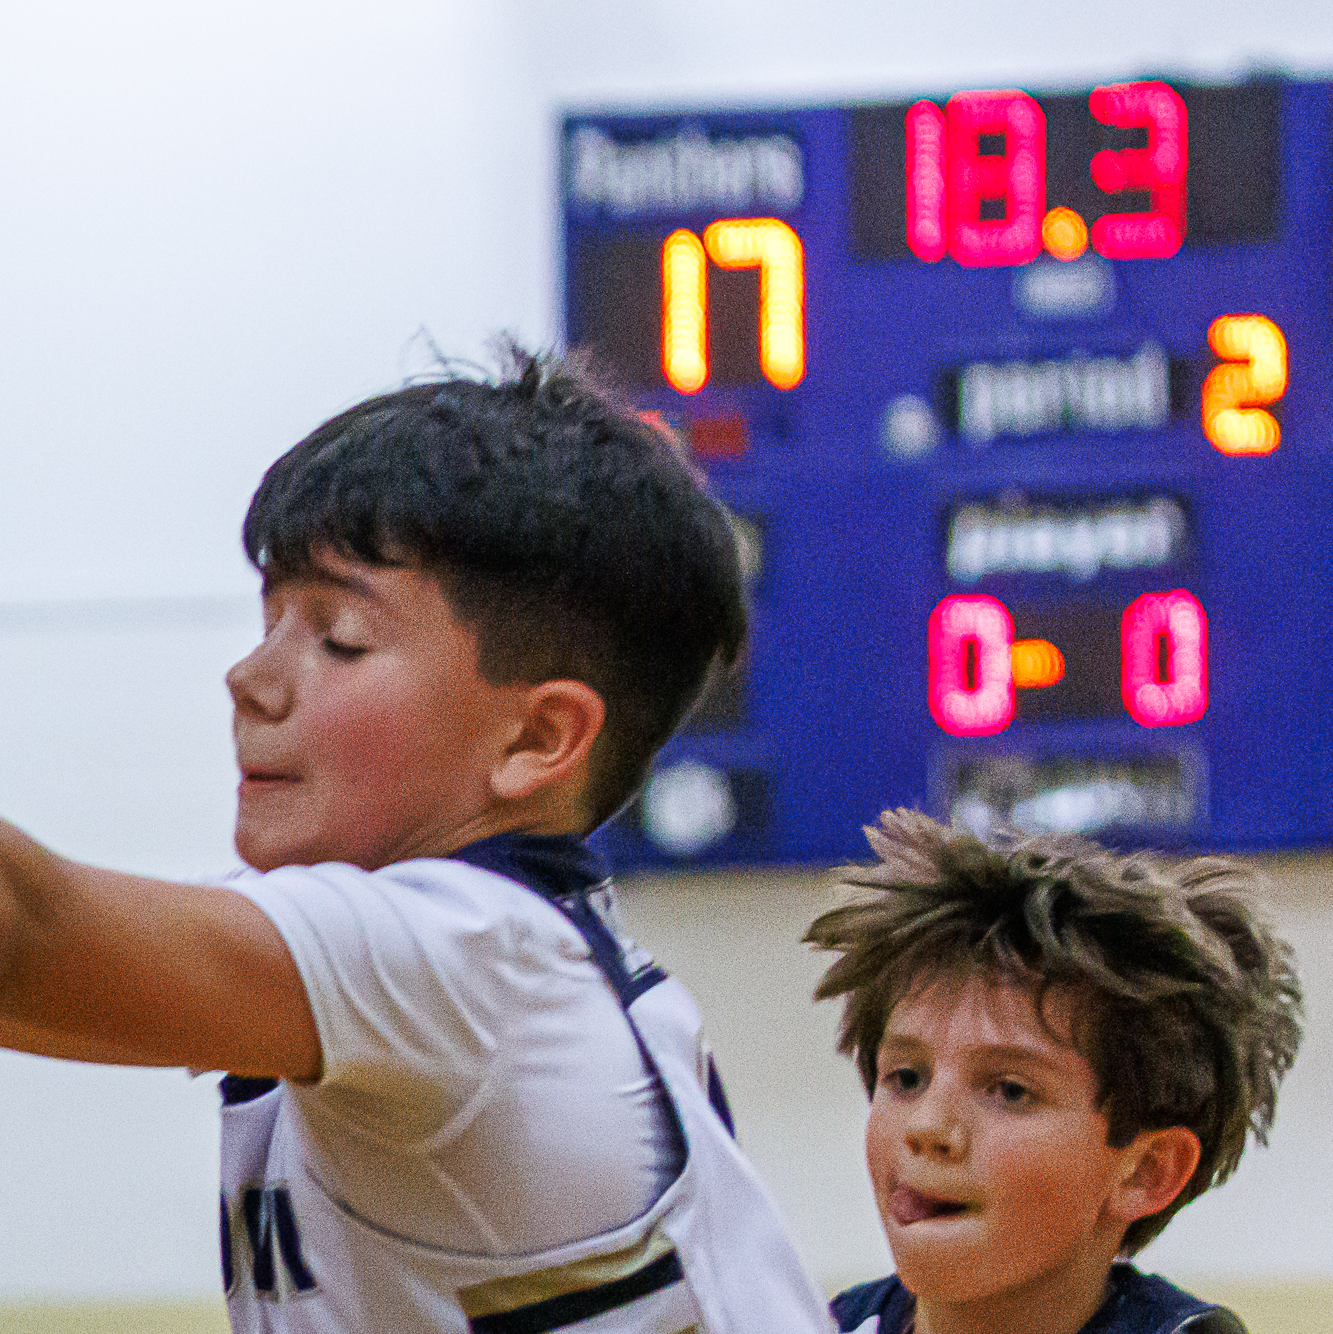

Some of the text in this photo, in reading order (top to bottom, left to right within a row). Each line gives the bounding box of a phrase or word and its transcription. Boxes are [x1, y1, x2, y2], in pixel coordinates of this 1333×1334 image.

[906, 80, 1188, 268] 18.3
[661, 217, 806, 395] 17
[1202, 313, 1289, 457] 2
[1121, 588, 1210, 729] 0
